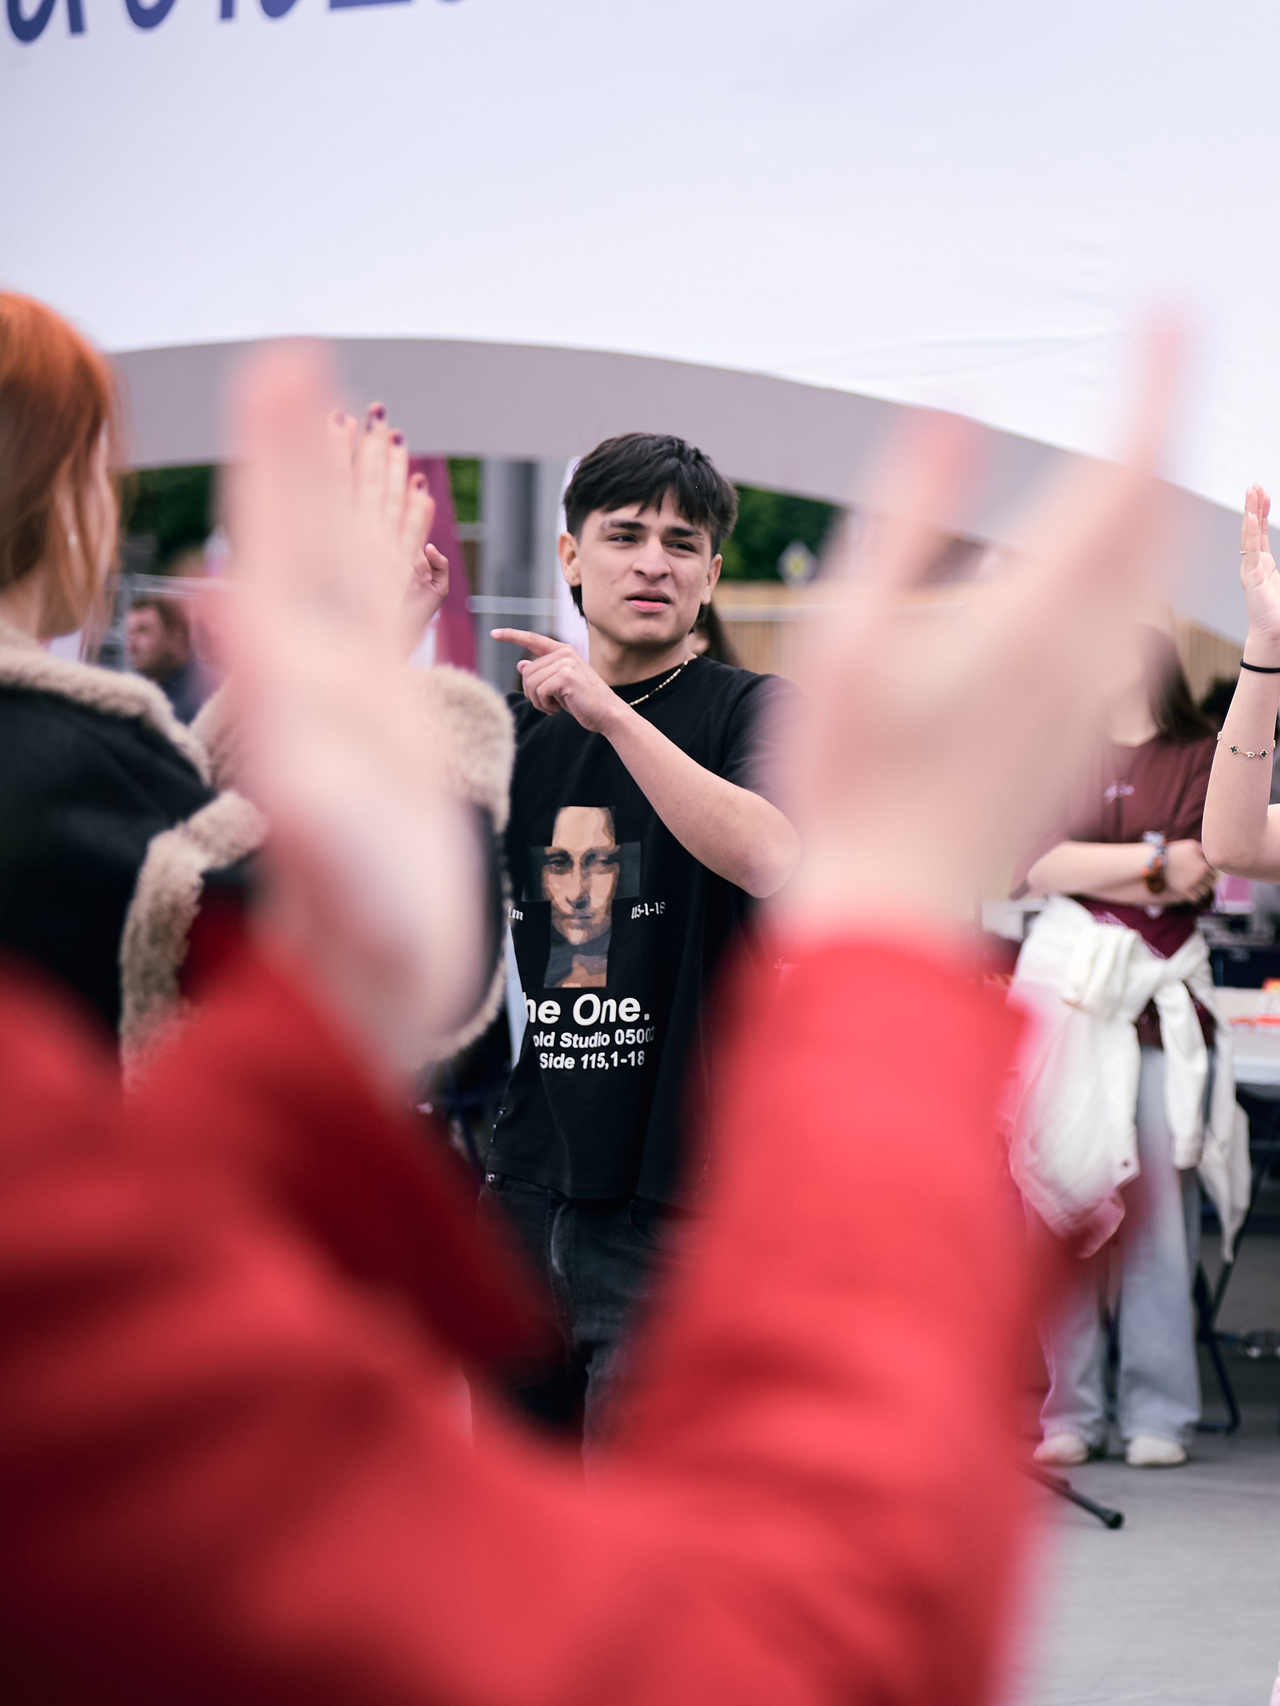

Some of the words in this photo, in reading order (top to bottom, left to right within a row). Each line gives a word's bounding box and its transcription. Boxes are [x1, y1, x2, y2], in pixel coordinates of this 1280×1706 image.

[572, 993, 650, 1026] One.
[559, 1031, 610, 1049] Studio
[539, 1052, 576, 1070] Side
[580, 1050, 645, 1071] 115,1-18
